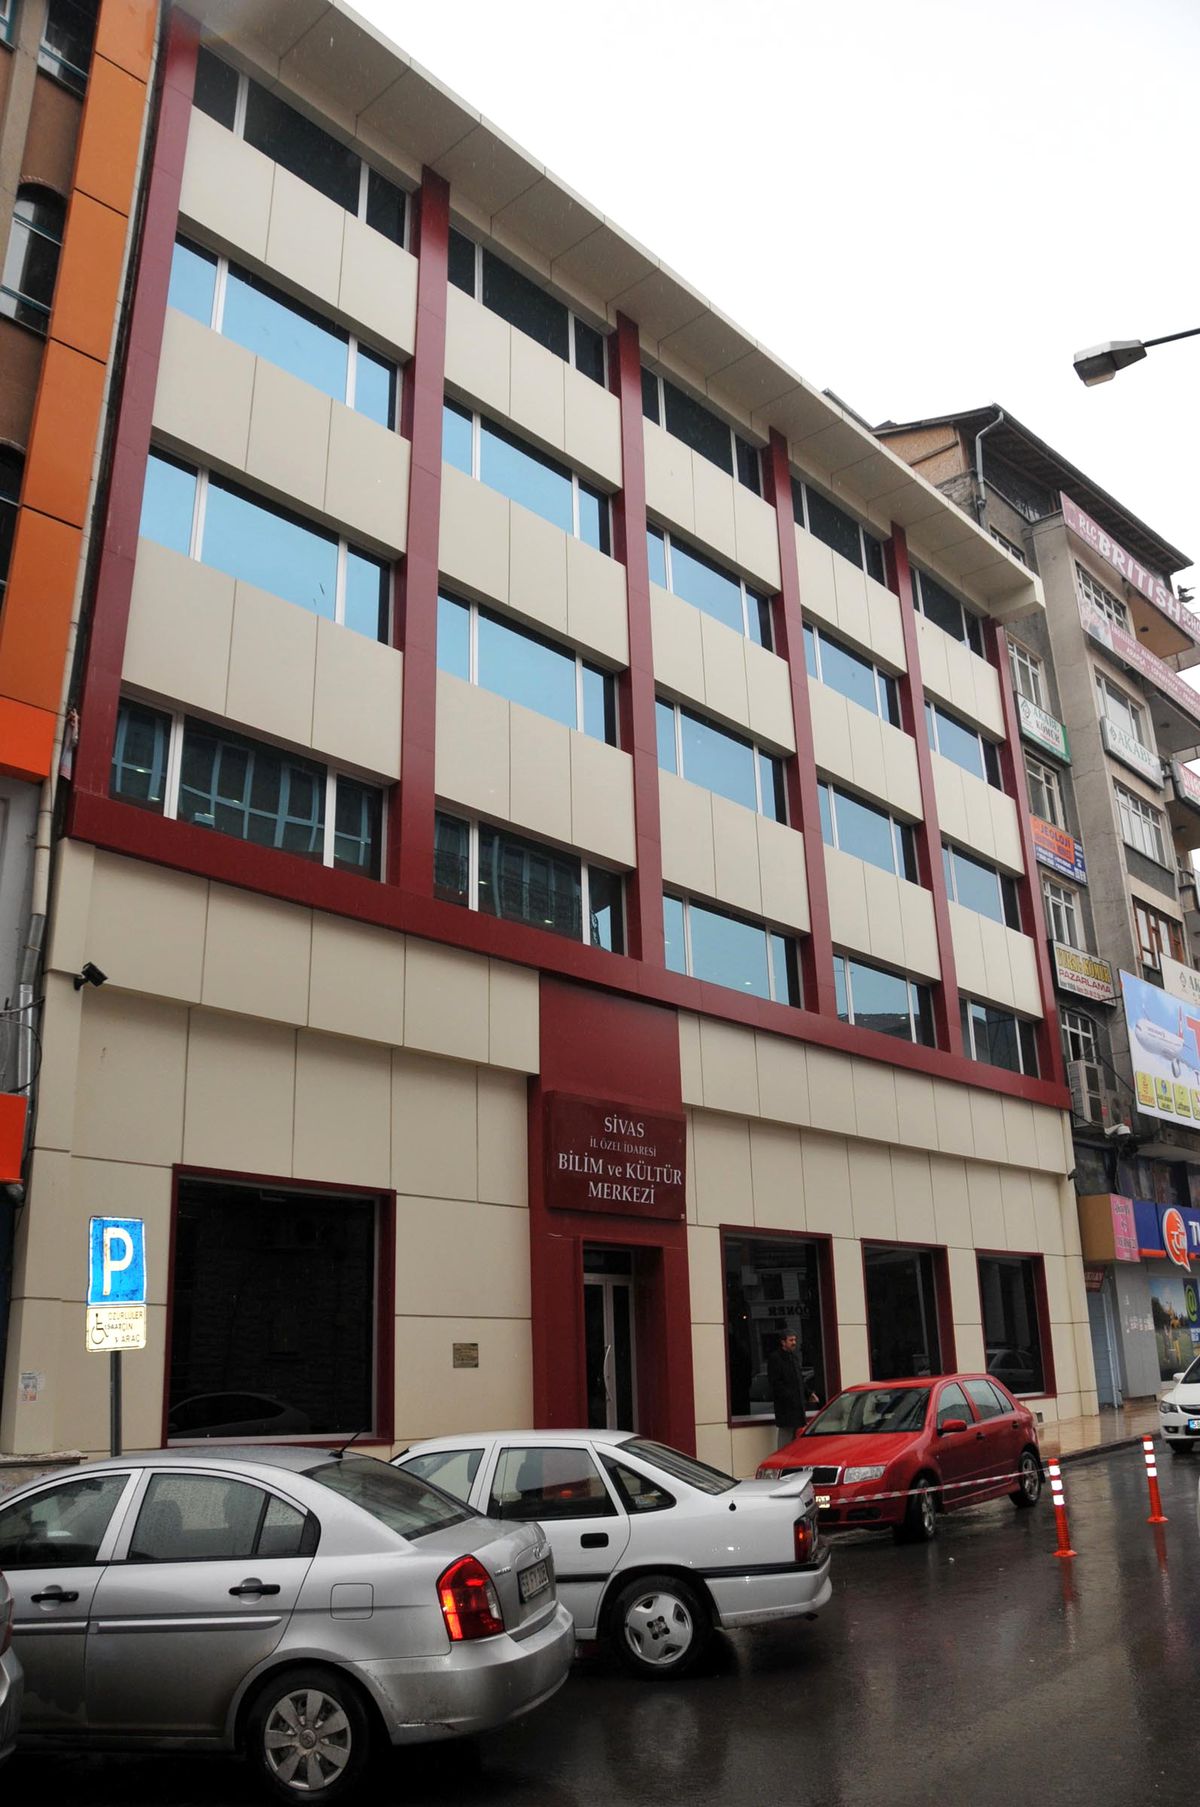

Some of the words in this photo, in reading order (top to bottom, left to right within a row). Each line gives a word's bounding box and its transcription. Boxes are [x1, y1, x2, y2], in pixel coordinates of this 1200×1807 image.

[1059, 970, 1111, 993] PAZARLAMA
[604, 1114, 645, 1138] SİVAS
[590, 1136, 599, 1149] İL
[600, 1137, 621, 1152] ÖZEL
[624, 1140, 657, 1157] İDARESİ
[558, 1150, 603, 1175] BİLİM
[607, 1165, 623, 1178] ve
[626, 1160, 682, 1185] KÜLTÜR
[588, 1181, 655, 1205] MERKEZİ
[102, 1226, 134, 1296] P
